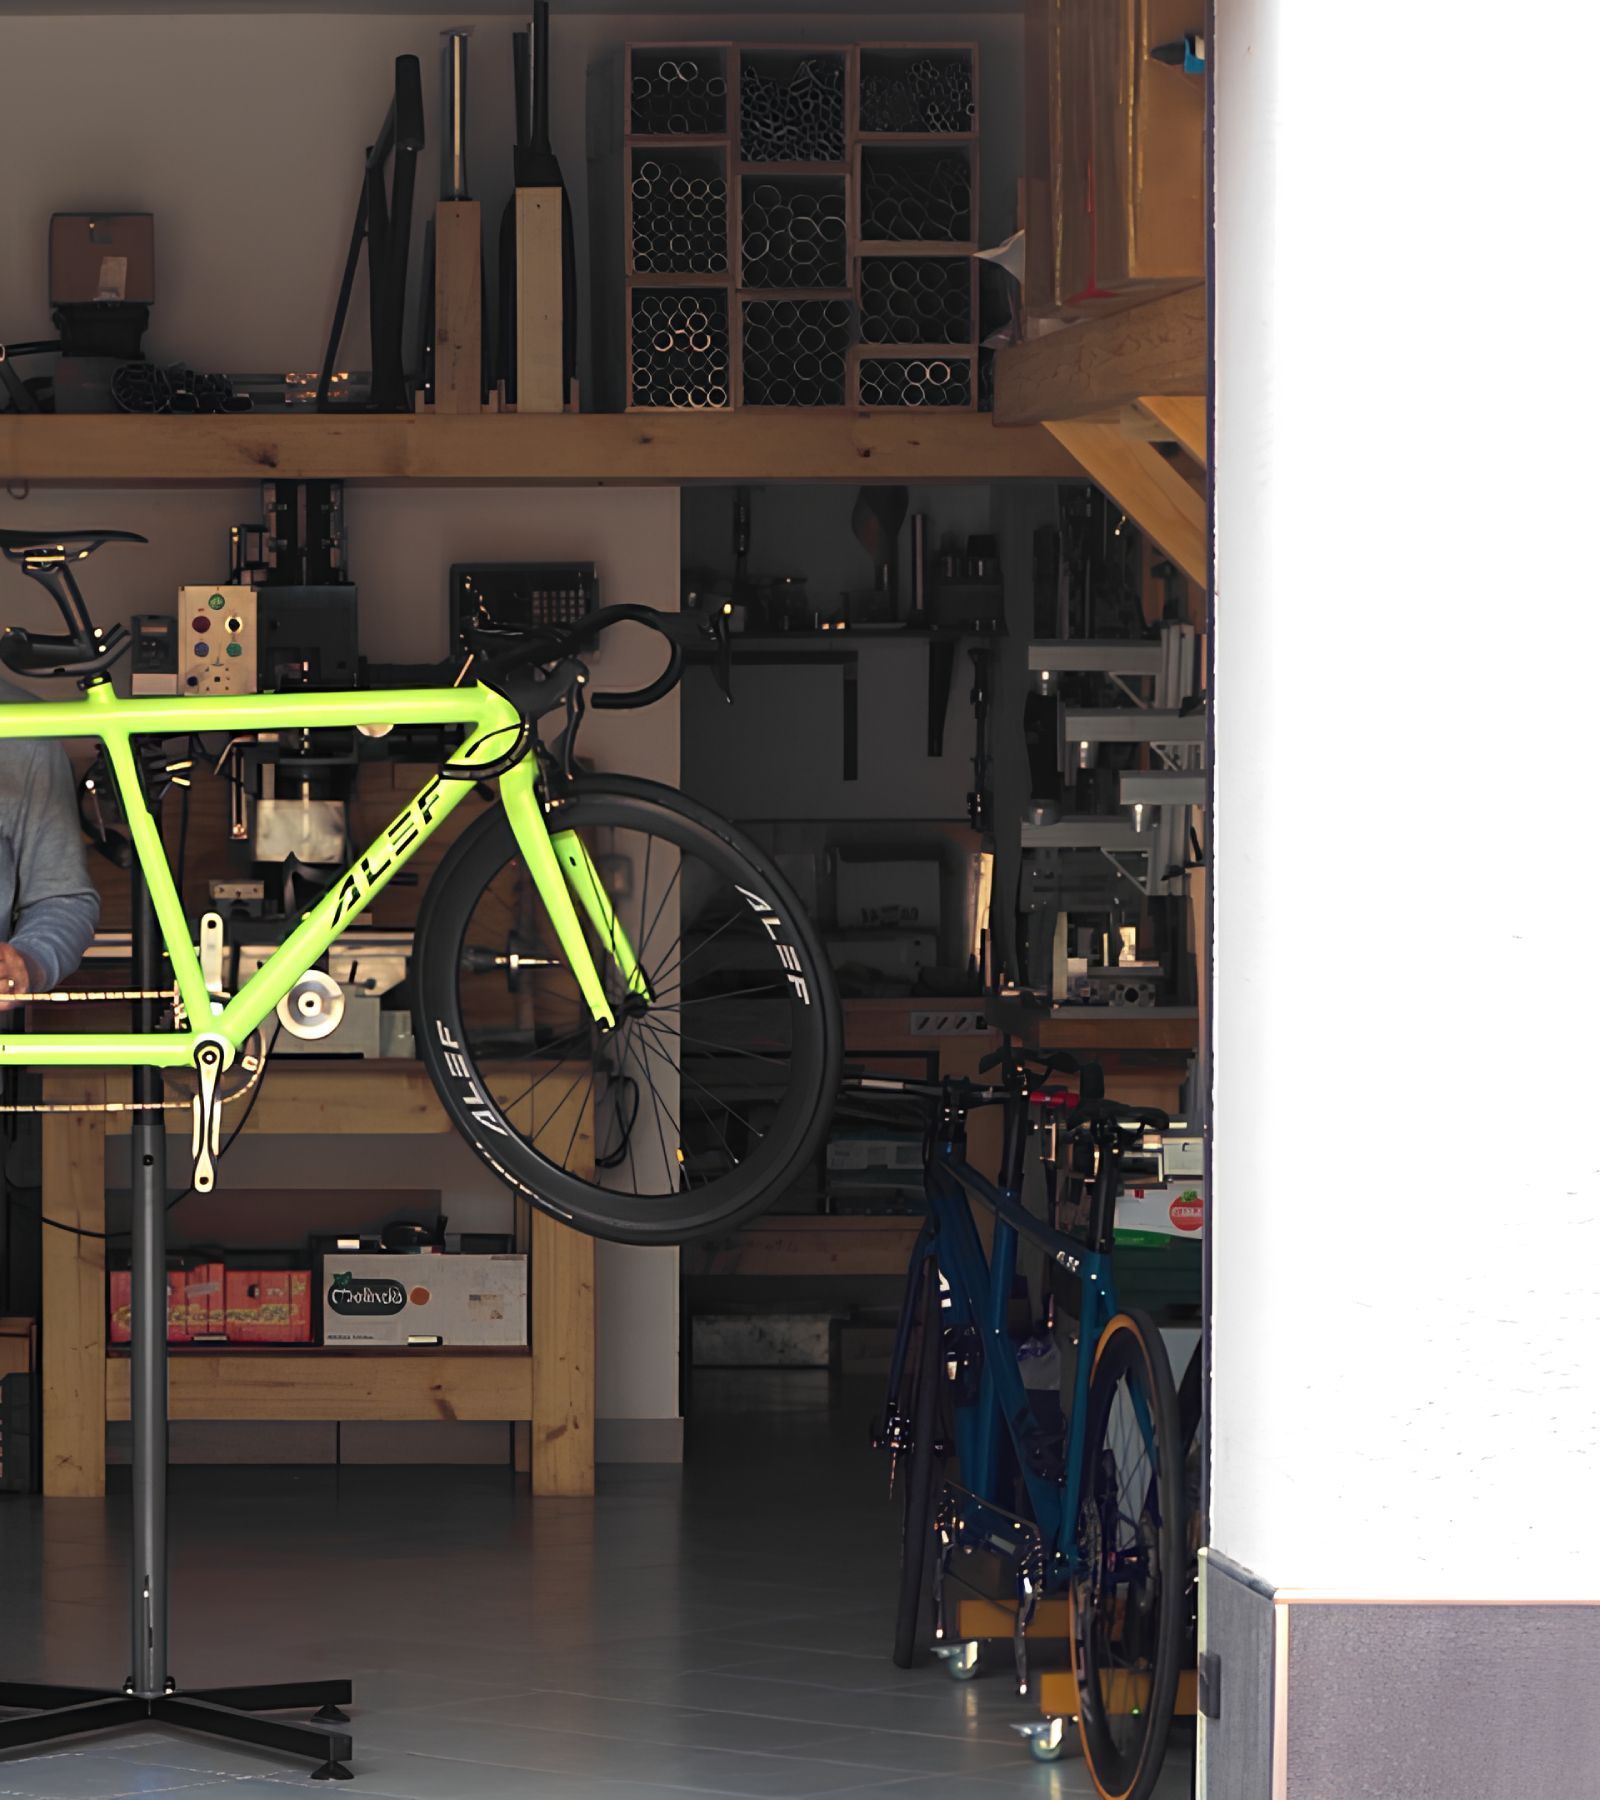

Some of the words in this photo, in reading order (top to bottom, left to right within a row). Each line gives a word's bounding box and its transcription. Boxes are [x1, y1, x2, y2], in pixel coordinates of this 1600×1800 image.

[331, 780, 441, 929] ALEF
[734, 884, 810, 1005] ALEF
[436, 1020, 509, 1136] ALEF
